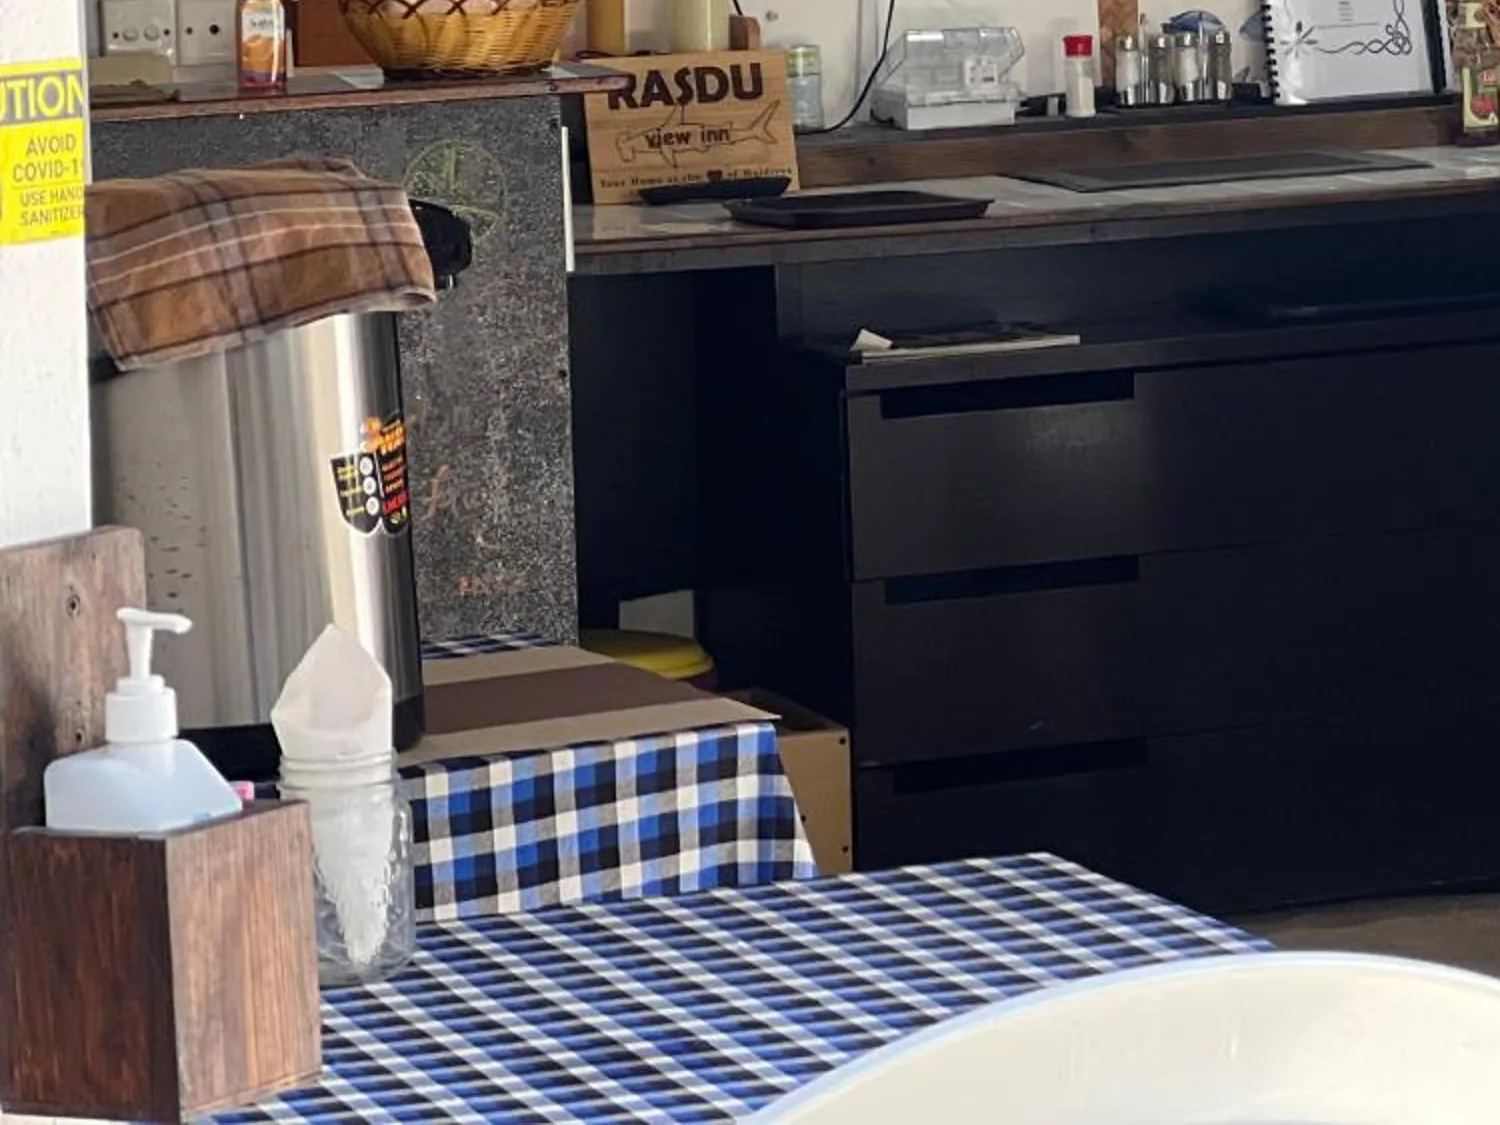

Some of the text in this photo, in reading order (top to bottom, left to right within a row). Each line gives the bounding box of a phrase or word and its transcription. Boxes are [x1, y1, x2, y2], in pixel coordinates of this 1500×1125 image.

[607, 62, 765, 110] RASDU
[26, 133, 77, 156] AVOID
[645, 127, 730, 148] view inn
[12, 157, 84, 183] COVID-1
[20, 189, 48, 208] USE
